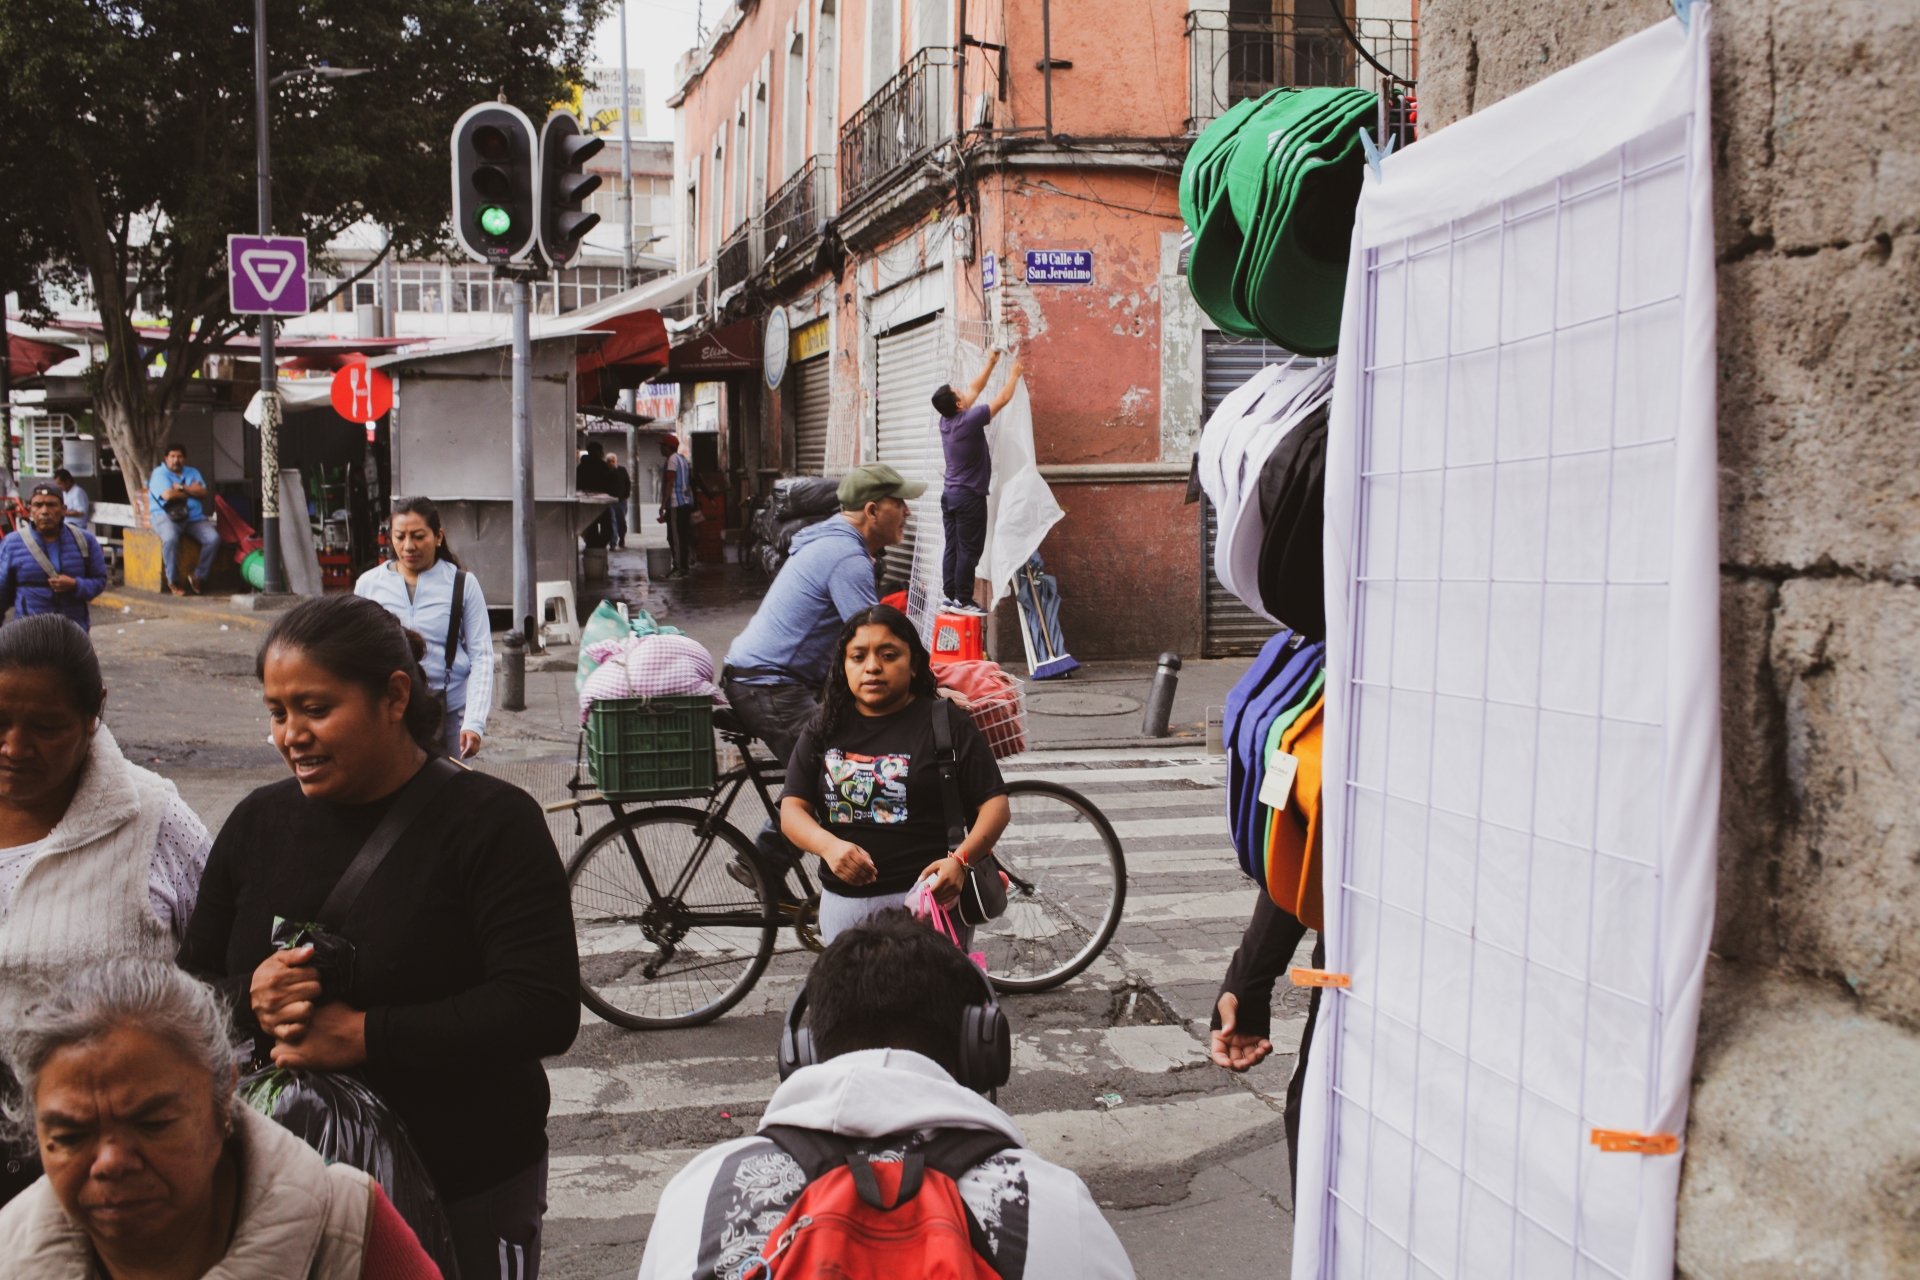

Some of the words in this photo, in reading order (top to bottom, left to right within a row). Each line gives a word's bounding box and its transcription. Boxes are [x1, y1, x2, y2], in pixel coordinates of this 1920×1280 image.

[1049, 252, 1072, 265] Calle
[1074, 252, 1085, 265] de
[1028, 266, 1047, 279] San
[1047, 266, 1091, 279] Jerónimo
